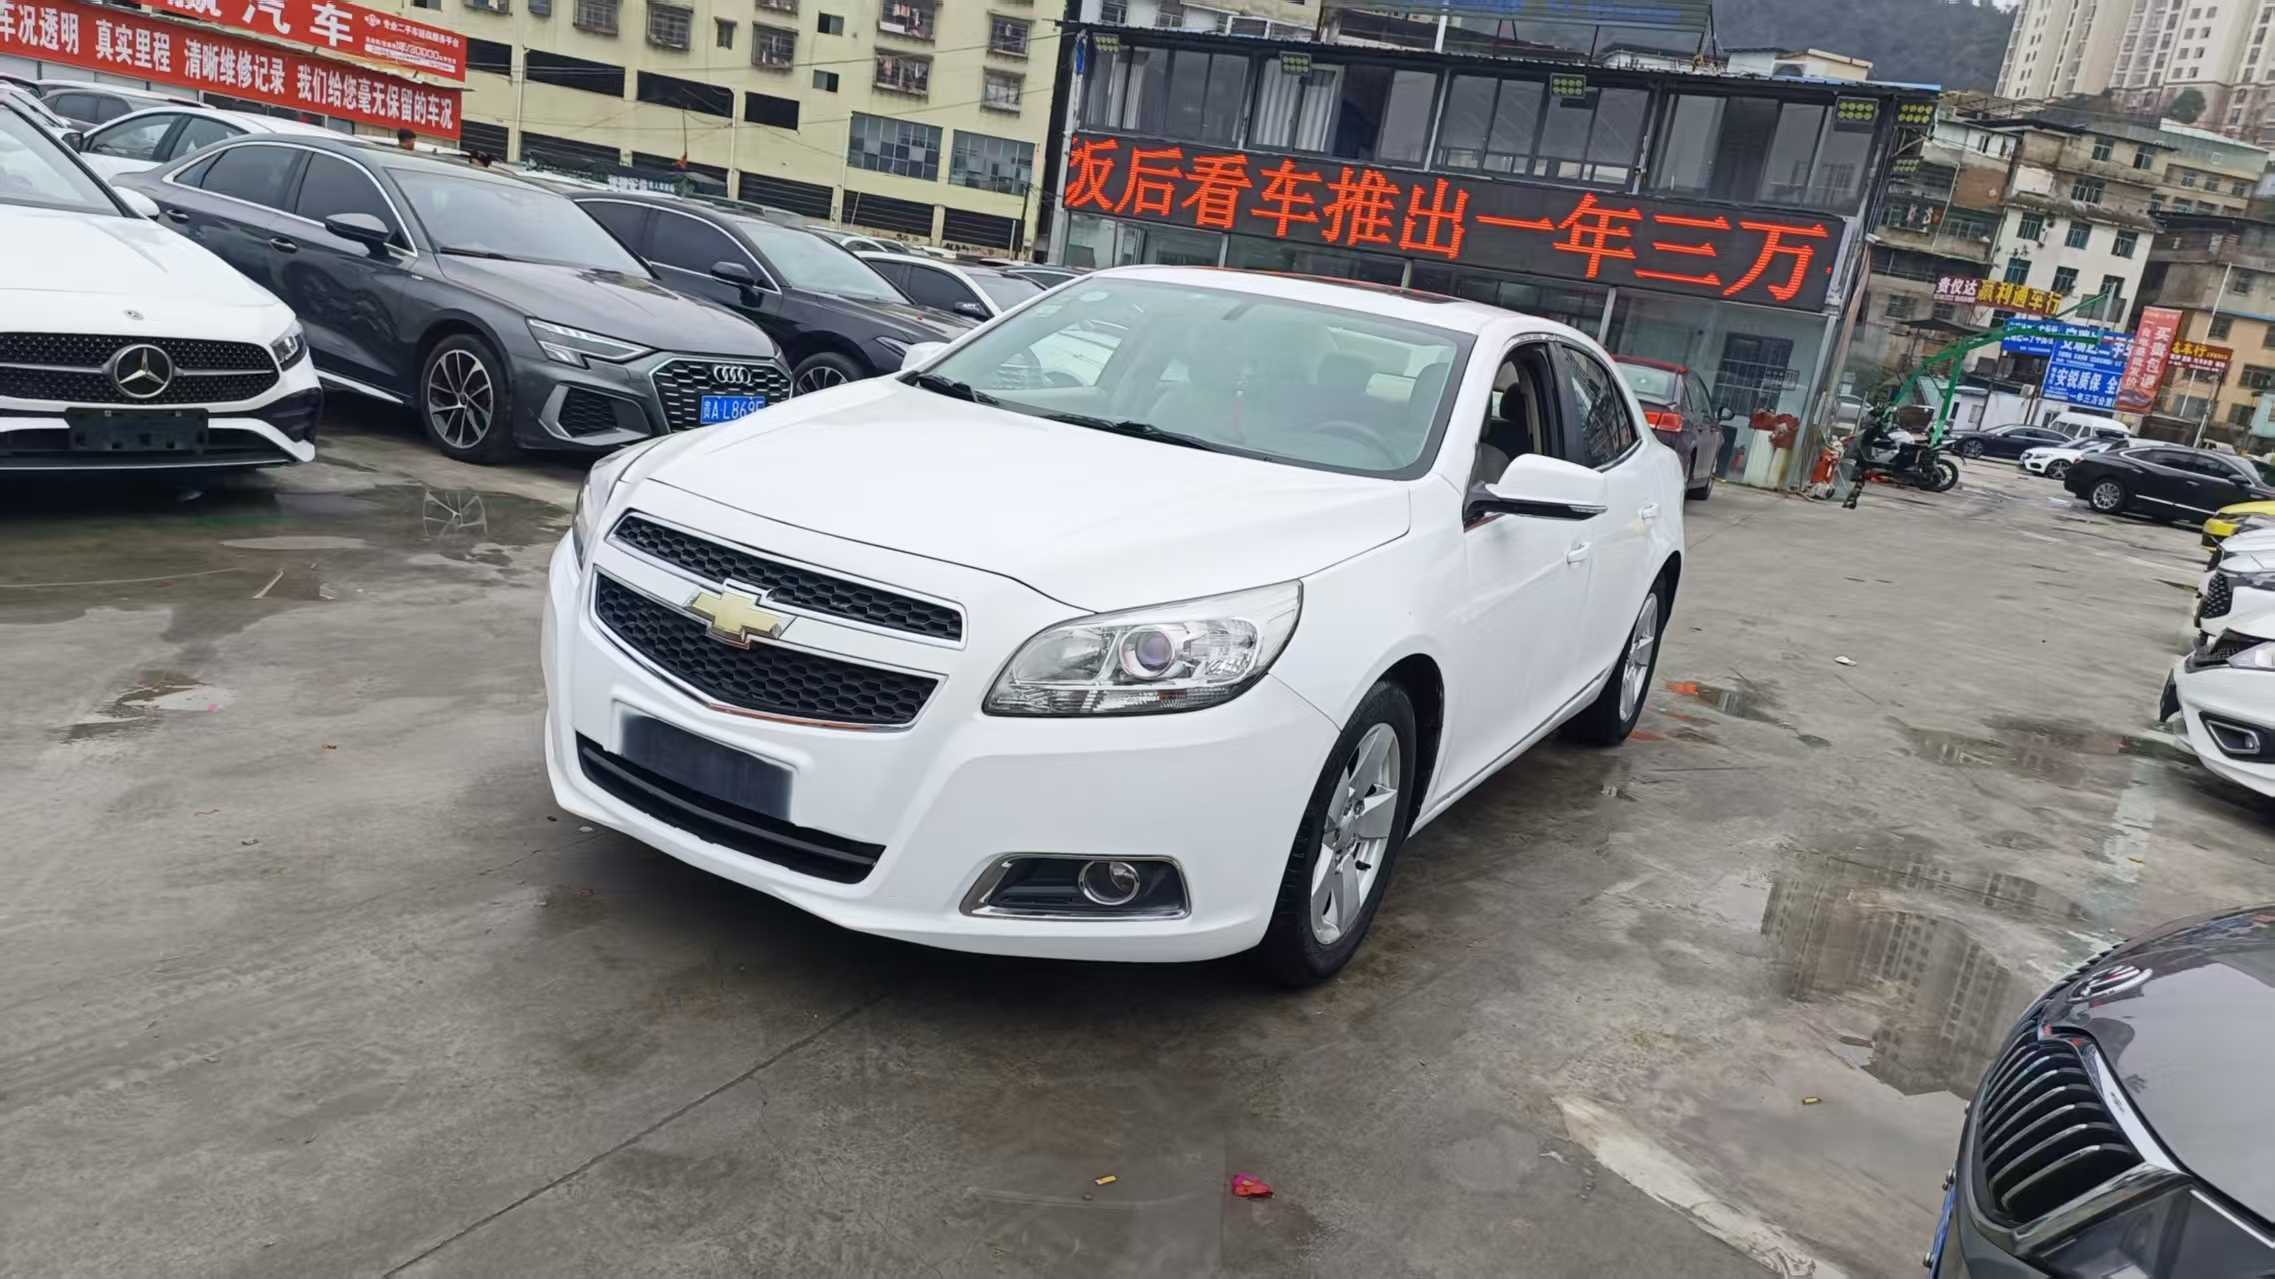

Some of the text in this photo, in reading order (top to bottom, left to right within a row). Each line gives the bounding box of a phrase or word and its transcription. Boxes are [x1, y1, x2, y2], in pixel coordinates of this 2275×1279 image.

[0, 2, 453, 130] 车况透明 真实里程 清晰维修记录 我们给您毫无保留的车况
